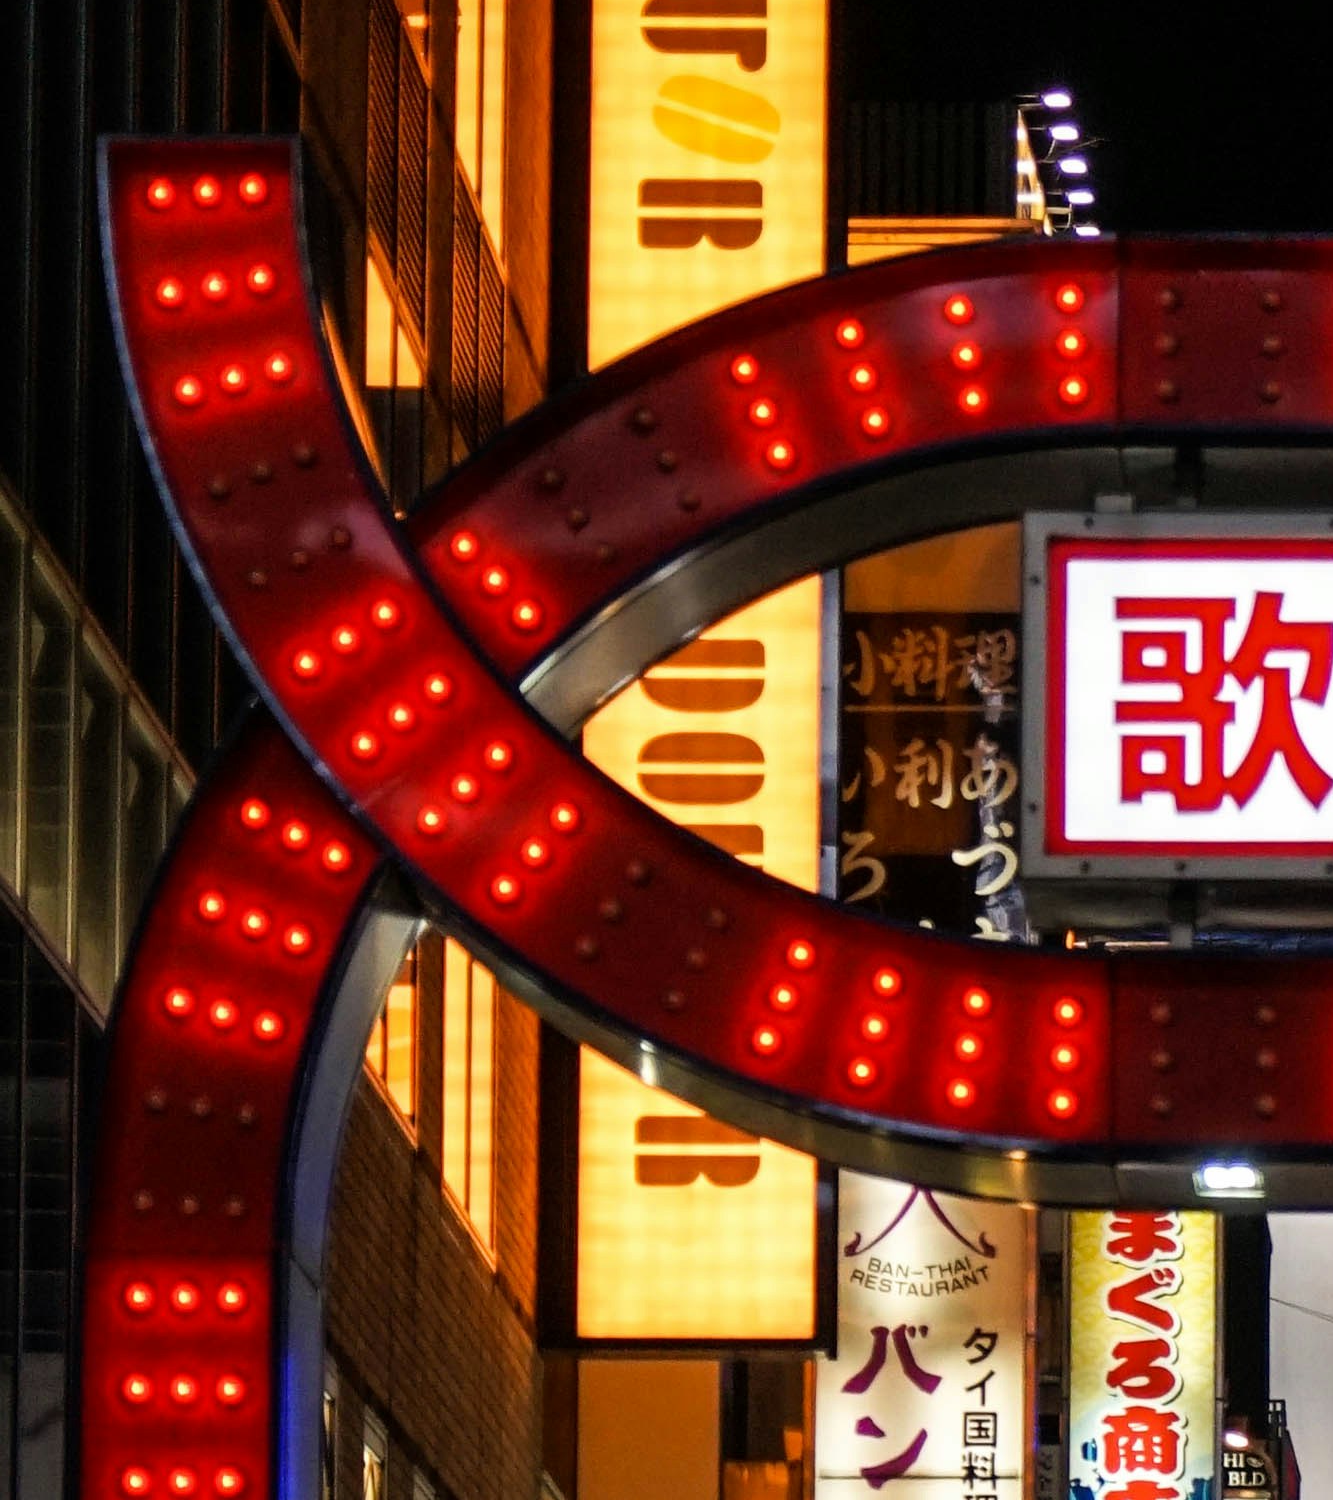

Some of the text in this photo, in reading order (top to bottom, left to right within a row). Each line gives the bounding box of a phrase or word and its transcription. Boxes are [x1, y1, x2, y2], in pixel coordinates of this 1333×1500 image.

[867, 1253, 973, 1282] BAN-THAI
[849, 1268, 992, 1300] RESTAURANT
[1228, 1471, 1265, 1487] BLD
